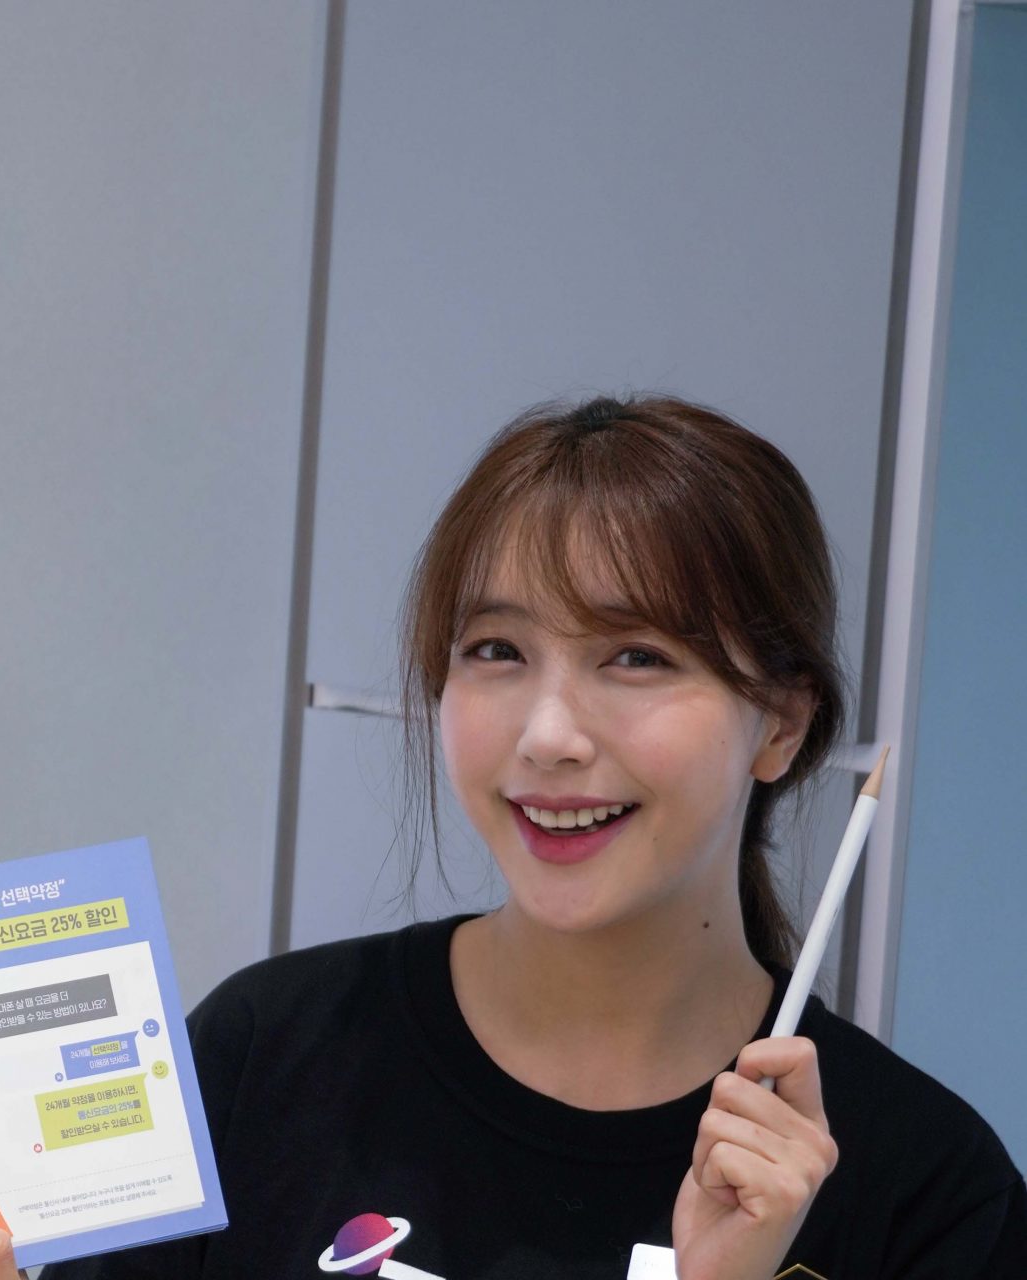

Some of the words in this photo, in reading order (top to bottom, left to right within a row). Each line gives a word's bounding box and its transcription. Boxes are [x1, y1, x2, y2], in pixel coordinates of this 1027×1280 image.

[51, 912, 82, 933] 25%
[84, 905, 118, 928] 할인
[34, 992, 59, 1006] 요금을
[60, 991, 69, 1001] 더
[27, 1013, 35, 1022] 수
[36, 1009, 52, 1020] 있는
[53, 1005, 77, 1018] 방법이
[78, 999, 107, 1013] 있나요?
[45, 1097, 71, 1111] 24개월
[71, 1093, 96, 1106] 약정을
[102, 1121, 110, 1130] 수
[111, 1114, 145, 1129] 있습니다.
